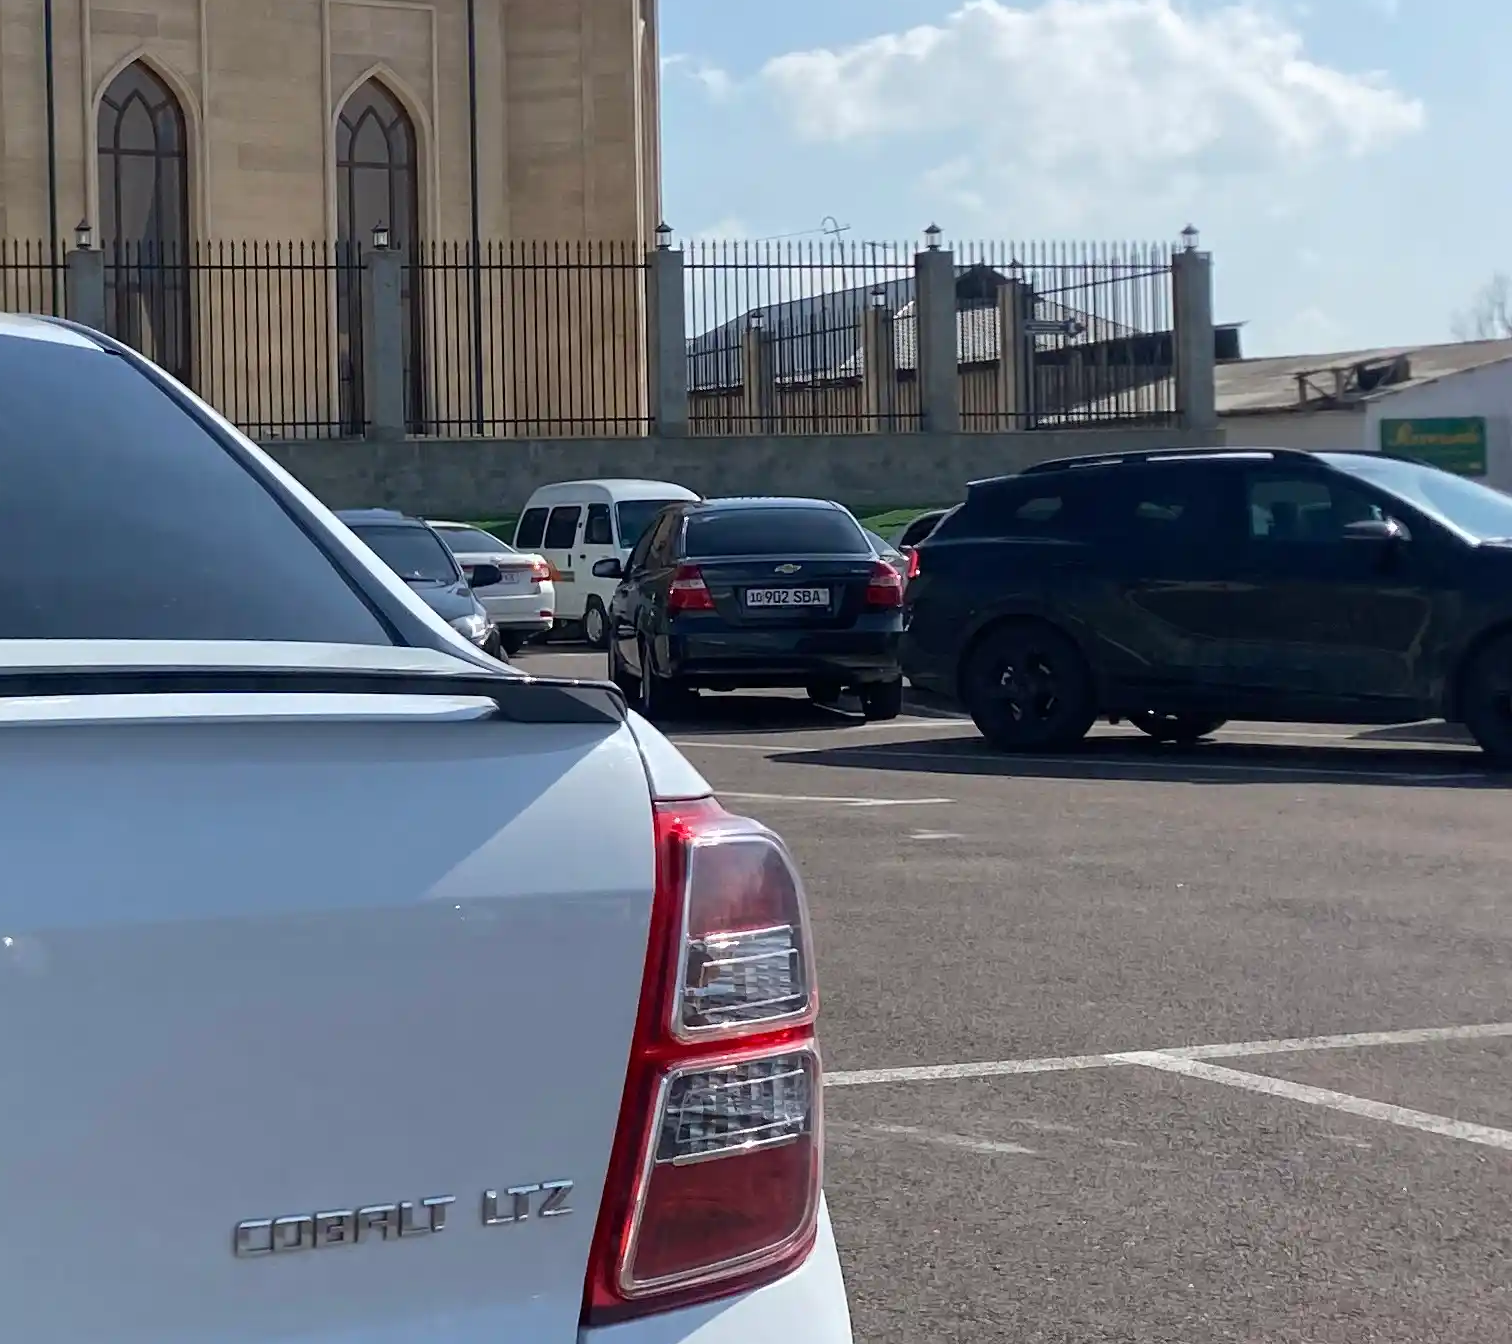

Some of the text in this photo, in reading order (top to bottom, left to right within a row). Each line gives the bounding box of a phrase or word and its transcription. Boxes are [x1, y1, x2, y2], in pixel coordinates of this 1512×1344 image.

[750, 590, 821, 604] 10 902 SBA
[235, 1179, 574, 1256] COBALT LTZ
